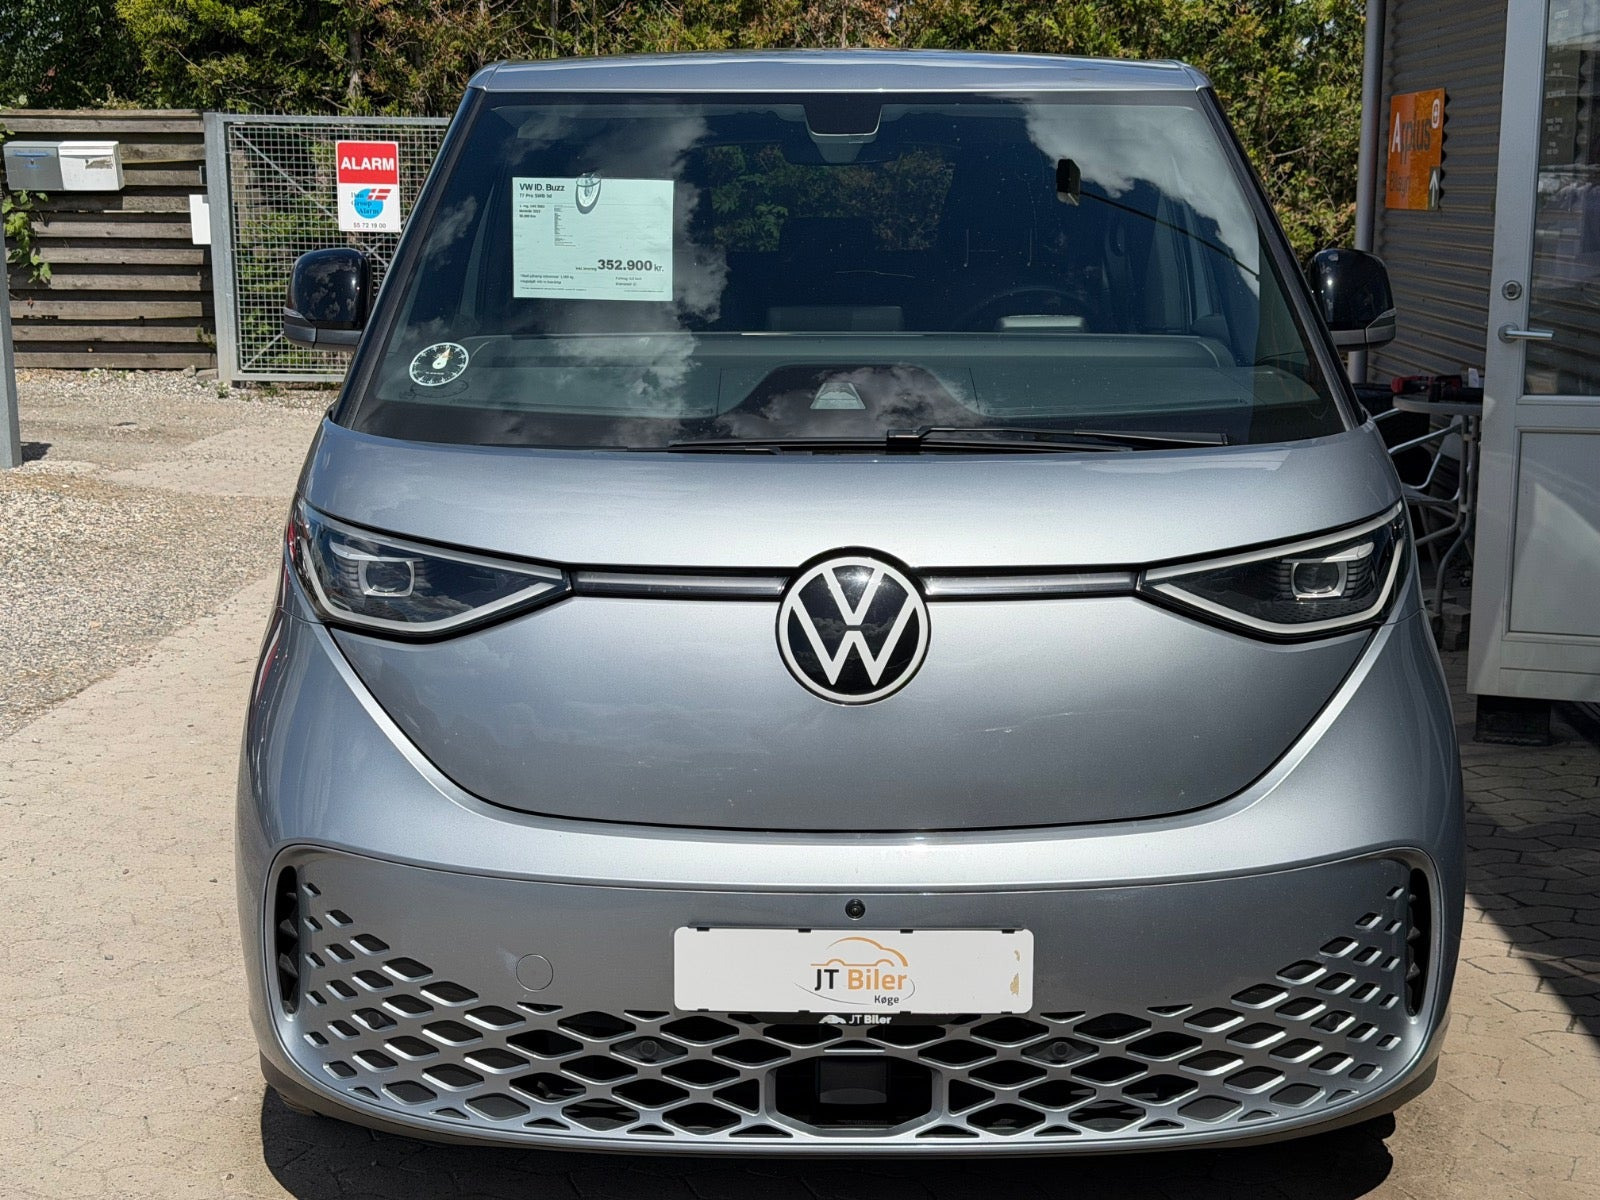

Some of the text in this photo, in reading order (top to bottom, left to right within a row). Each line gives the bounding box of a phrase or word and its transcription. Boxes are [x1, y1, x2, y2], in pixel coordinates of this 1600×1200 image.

[341, 157, 395, 171] ALARM
[519, 183, 565, 192] VW ID. Buzz
[597, 259, 653, 271] 352.900
[814, 968, 908, 992] JT Biler
[874, 994, 900, 1006] Køge
[848, 1014, 892, 1025] JT Biler
